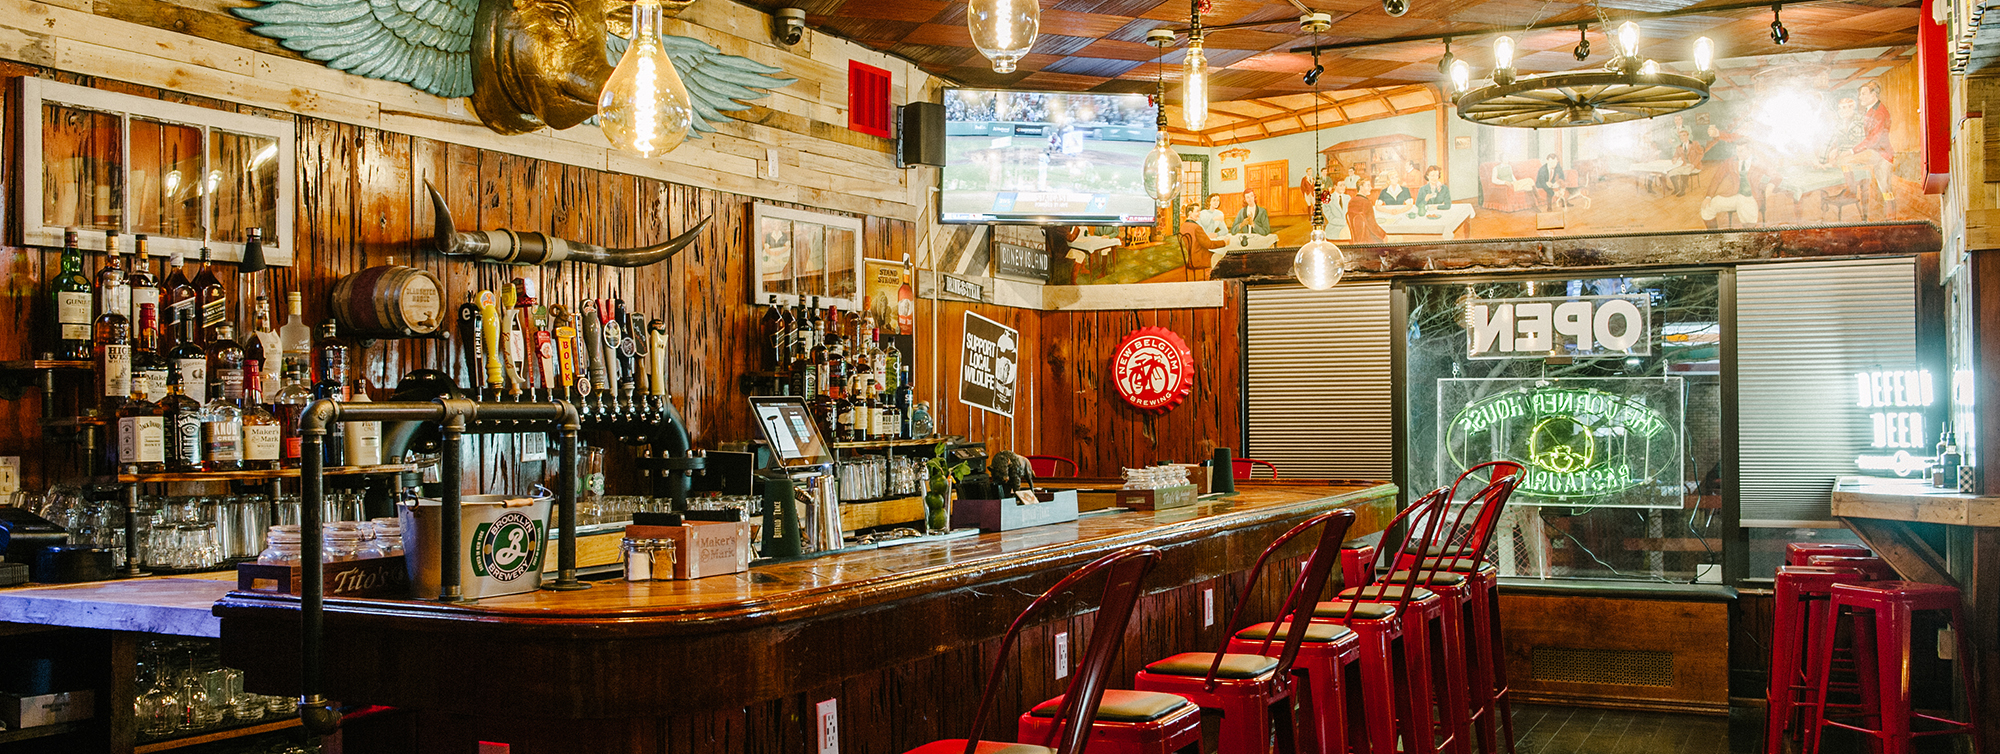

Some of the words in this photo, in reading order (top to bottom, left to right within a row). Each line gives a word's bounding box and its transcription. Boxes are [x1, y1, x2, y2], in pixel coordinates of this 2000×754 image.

[1002, 247, 1024, 267] CONEY
[1025, 250, 1048, 271] ISLAND
[878, 275, 900, 285] STRONG
[879, 268, 898, 277] STAND
[474, 325, 482, 358] EMPIRE
[966, 332, 997, 358] SUPPORT
[563, 341, 571, 381] BOCK
[969, 350, 991, 373] LOCAL
[1119, 348, 1132, 374] NEW
[1134, 339, 1178, 370] BELGIUM
[964, 365, 995, 390] WILDLIFE
[1130, 391, 1172, 406] BREWING
[214, 422, 237, 436] KNOB
[251, 428, 279, 436] Maker's
[490, 514, 534, 536] BROOKLYN
[701, 535, 736, 549] Maker's
[709, 548, 735, 560] Mark
[333, 566, 389, 594] Tito's
[488, 560, 528, 581] BREWERY
